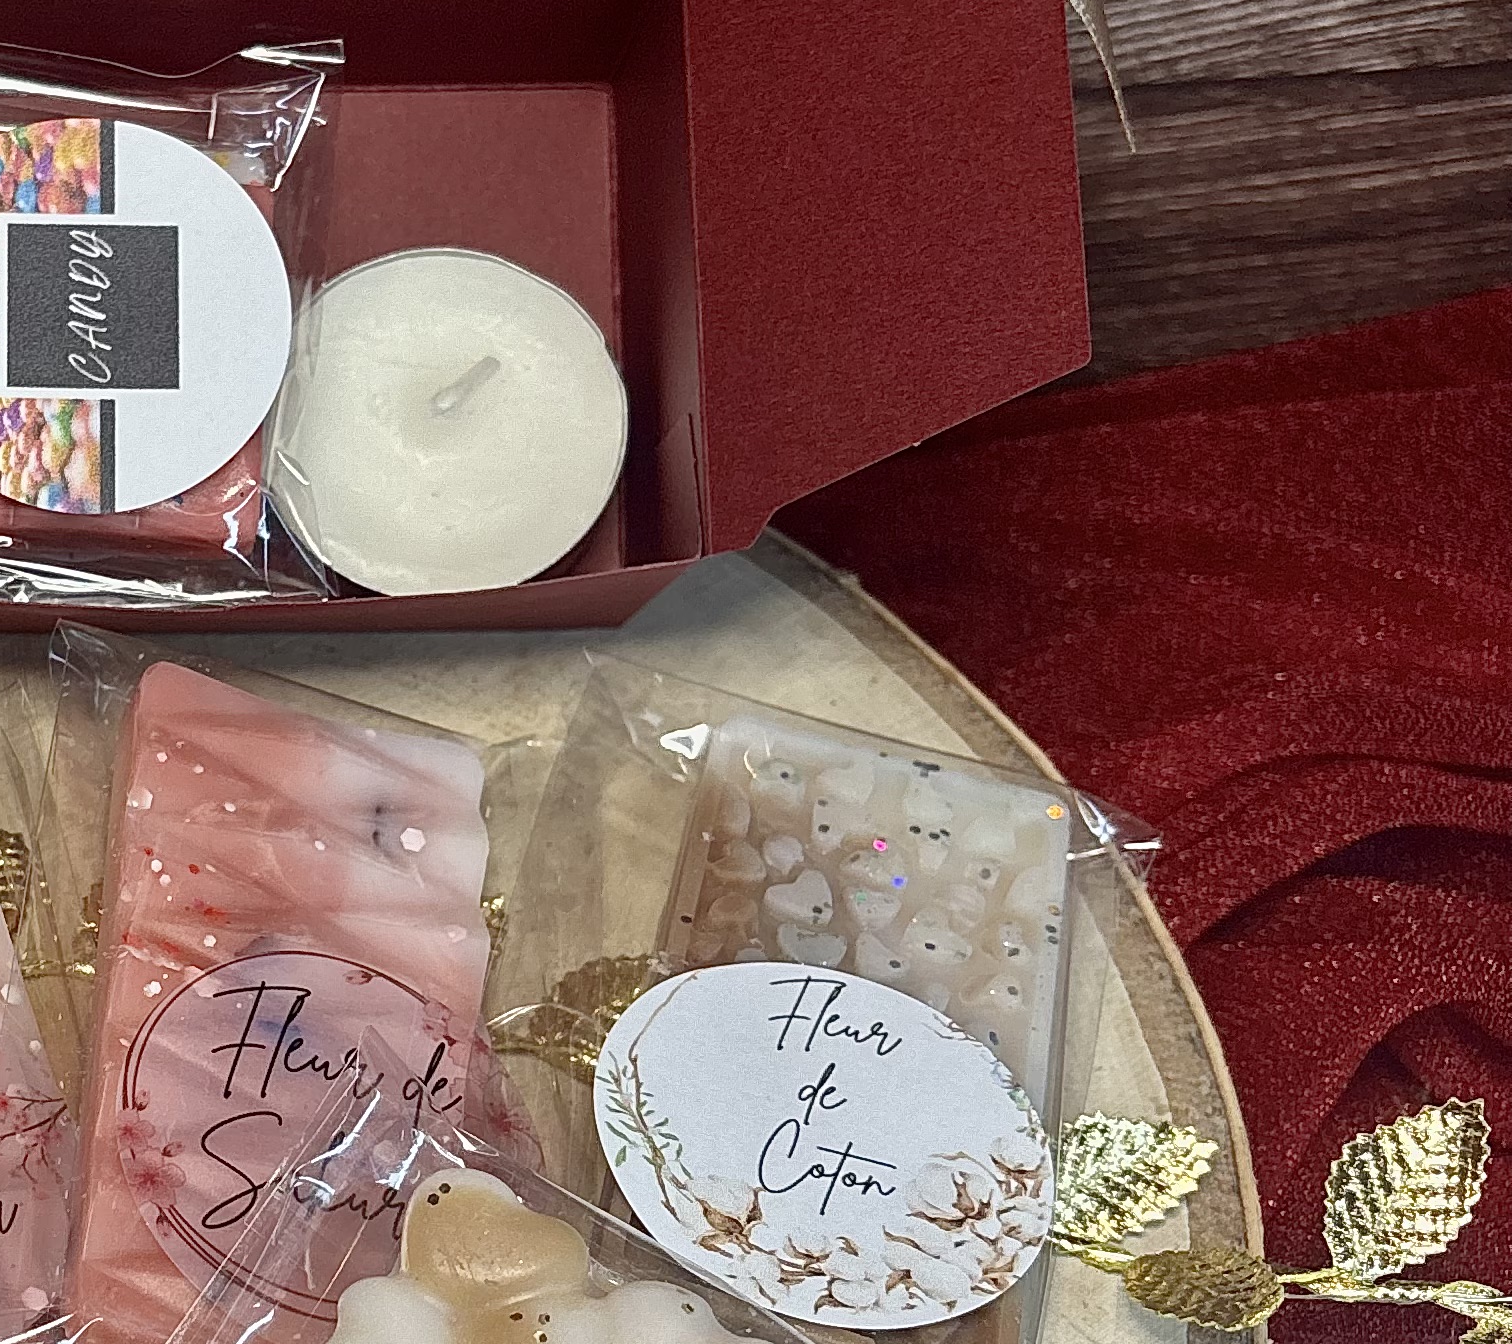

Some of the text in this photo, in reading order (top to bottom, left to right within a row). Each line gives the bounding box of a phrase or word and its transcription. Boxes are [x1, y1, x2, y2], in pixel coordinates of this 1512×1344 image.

[67, 229, 114, 383] CANDY
[211, 981, 463, 1132] Fleur de
[768, 976, 902, 1056] Fleur
[798, 1062, 848, 1126] de
[758, 1118, 897, 1216] Coton
